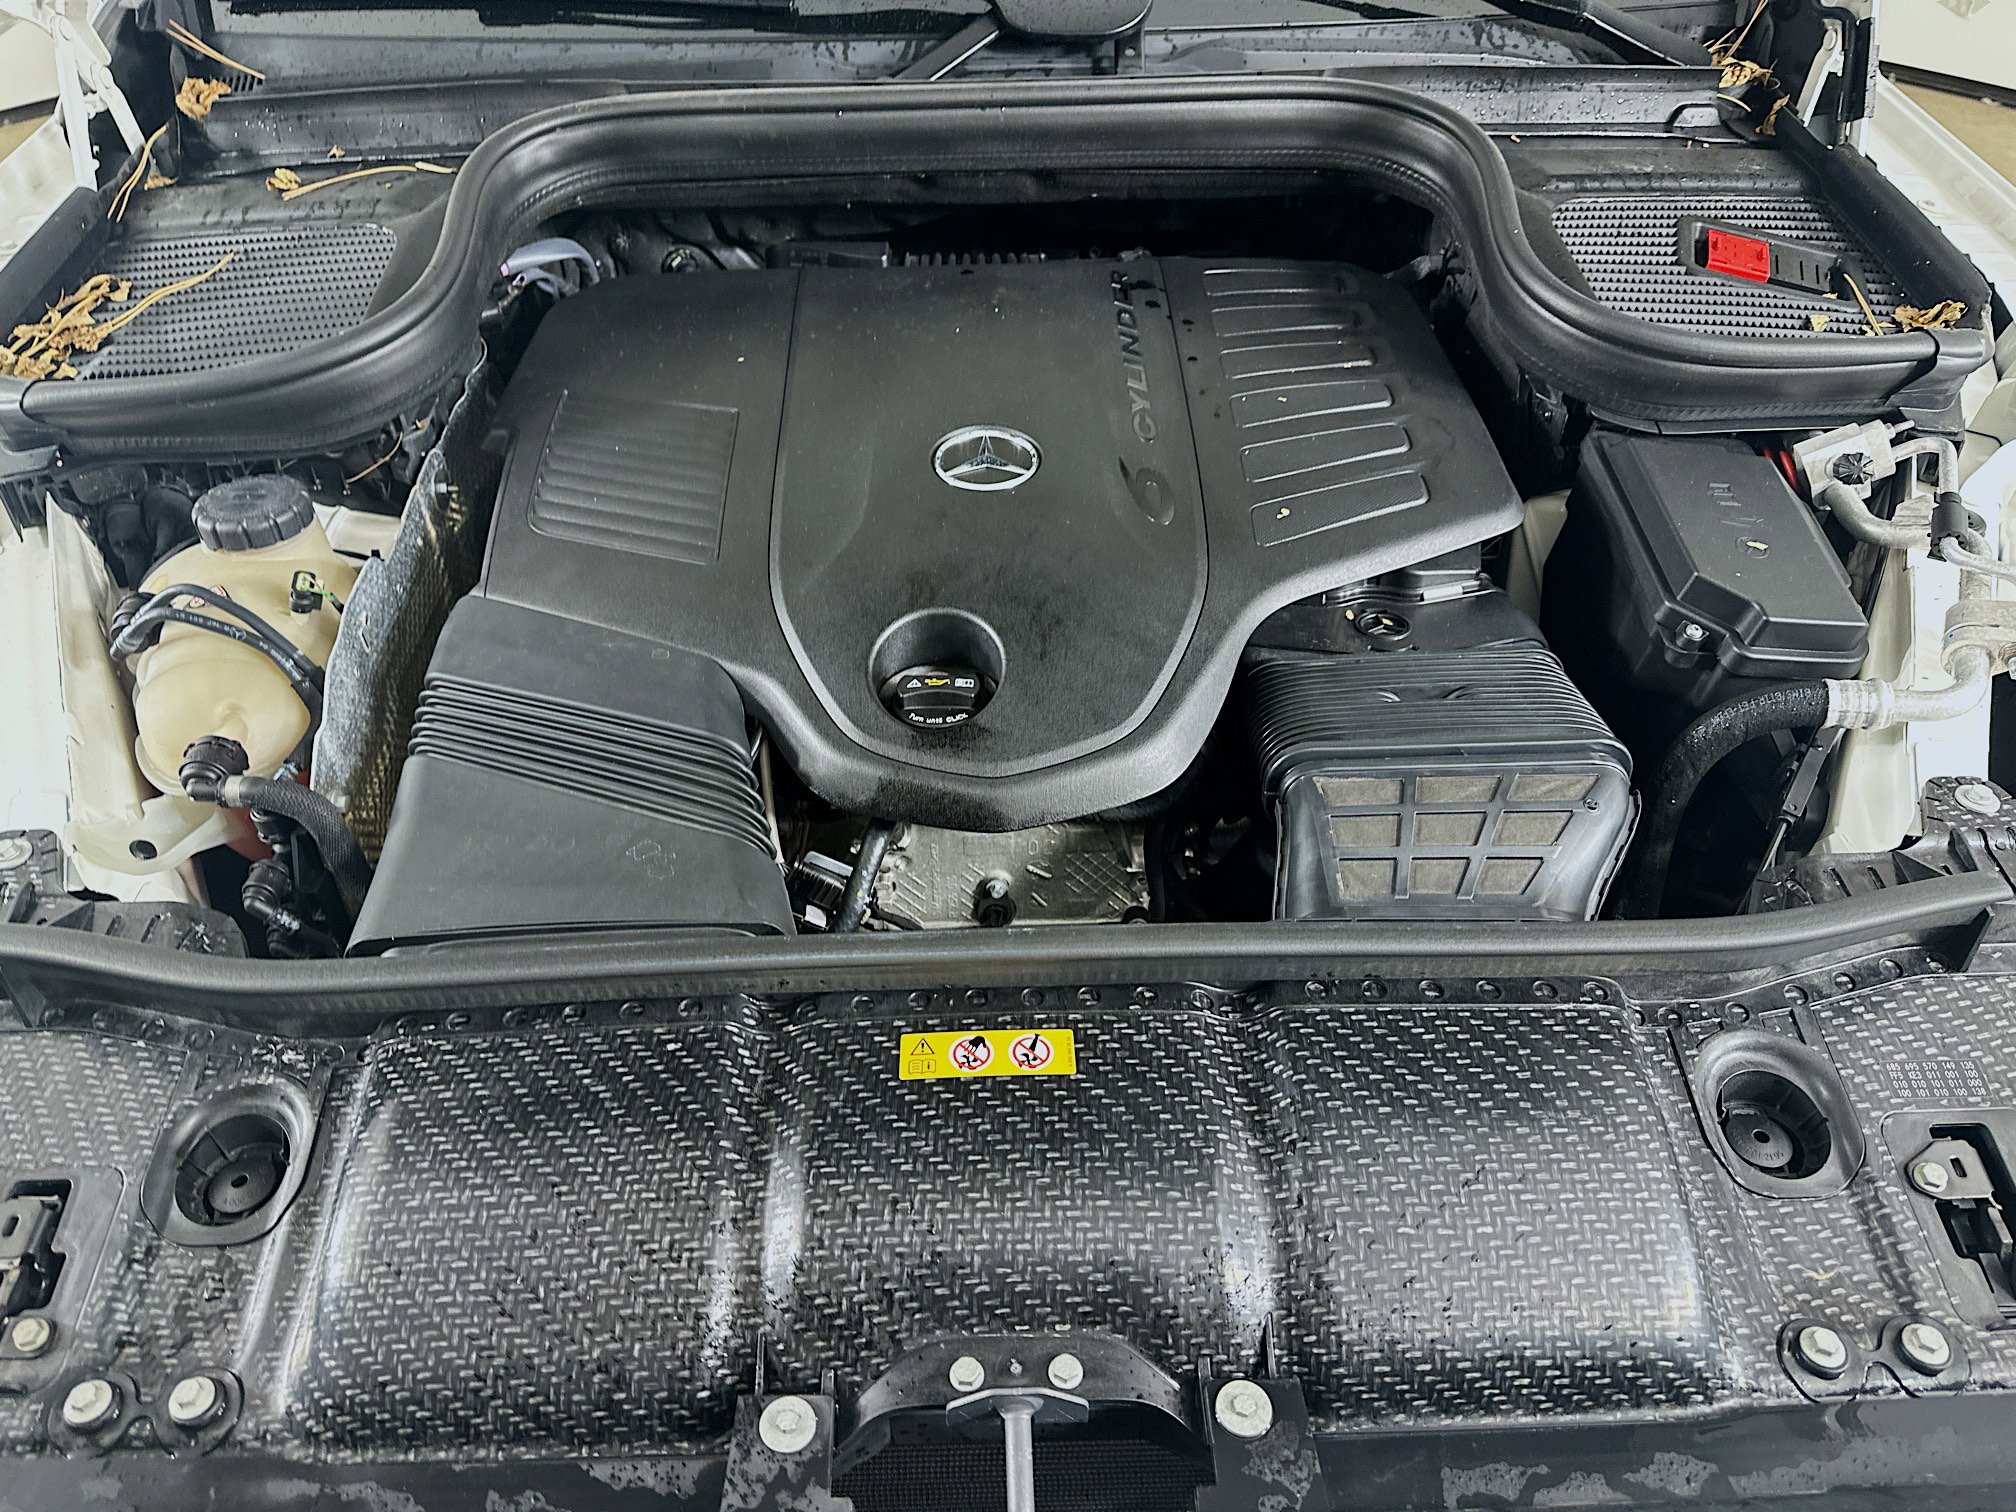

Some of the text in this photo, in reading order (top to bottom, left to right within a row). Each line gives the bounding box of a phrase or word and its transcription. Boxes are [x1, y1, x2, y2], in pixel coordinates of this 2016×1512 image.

[1111, 270, 1157, 443] CYLINDER
[908, 712, 969, 724] Turn until CLICK
[1922, 1062, 1938, 1070] 570
[1960, 1061, 1975, 1069] 135
[1926, 1071, 1941, 1079] 011
[1944, 1070, 1960, 1079] 001
[1964, 1070, 1979, 1078] 100
[1893, 1079, 1983, 1088] 010 010 101 011 000
[1897, 1089, 1912, 1097] 100
[1916, 1089, 1931, 1097] 101
[1934, 1089, 1949, 1097] 010
[1953, 1088, 1968, 1096] 100
